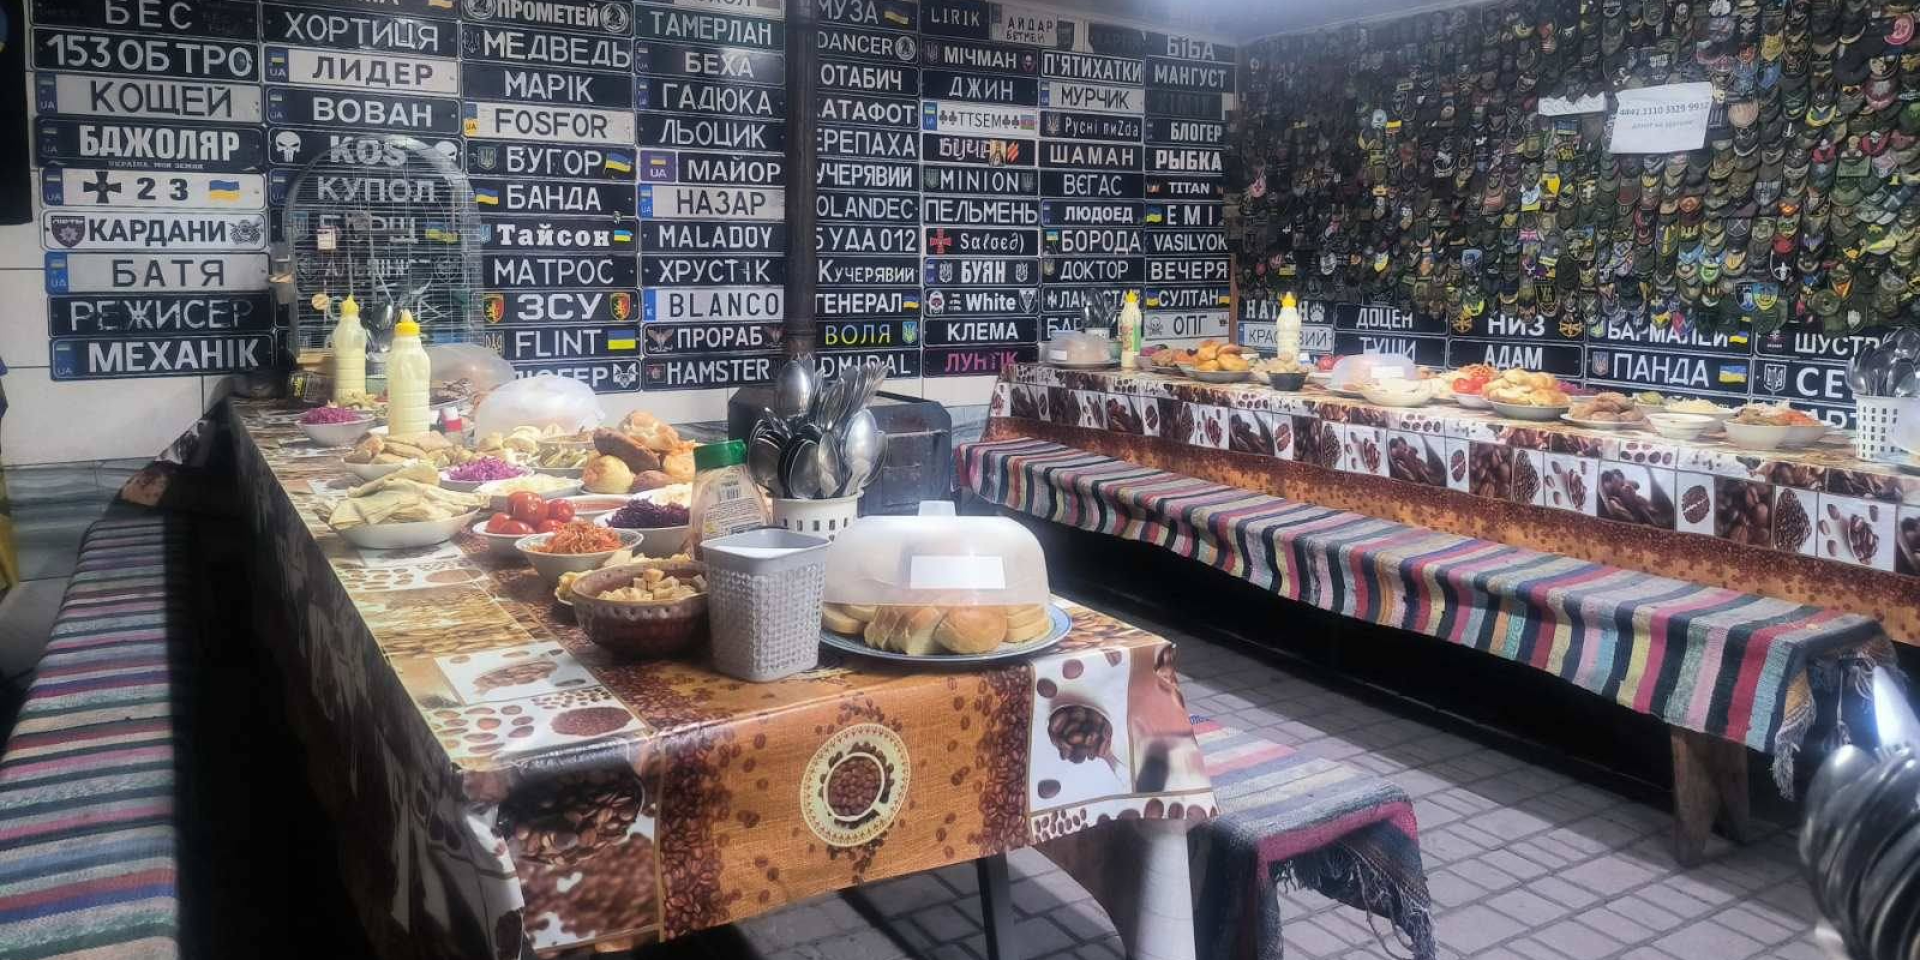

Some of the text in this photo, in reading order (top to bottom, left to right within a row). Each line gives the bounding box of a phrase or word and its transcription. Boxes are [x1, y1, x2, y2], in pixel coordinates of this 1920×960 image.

[105, 0, 192, 29] БЕС
[497, 0, 599, 27] ПРОМЕТЕЙ
[931, 9, 980, 27] LIRIK
[285, 12, 438, 52] ХОРТИЦЯ
[650, 11, 772, 45] ТАМЕРЛАН
[46, 34, 111, 67] 153
[175, 43, 253, 77] ТРО
[483, 30, 631, 68] МЕДВЕДЬ
[818, 31, 892, 55] DANCER
[684, 52, 754, 78] БЕХА
[944, 46, 1017, 69] МІЧМАН
[1043, 53, 1142, 83] П'ЯТИХАТКИ
[269, 69, 286, 77] UA
[312, 56, 433, 87] ЛИДЕР
[1154, 64, 1227, 89] МАНГУСТ
[90, 80, 232, 118] КОЩЕЙ
[504, 70, 594, 103] МАРІК
[662, 83, 773, 115] ГАДЮКА
[948, 77, 1014, 101] ДЖИН
[1061, 86, 1130, 110] МУРЧИК
[312, 96, 433, 127] ВОВАН
[494, 108, 608, 139] FOSFOR
[818, 99, 916, 125] АТАФОТ
[958, 111, 1002, 128] TTSEM
[79, 124, 240, 163] БДЖОЛЯР
[659, 118, 766, 149] ЛЬОЦИК
[817, 128, 916, 157] ЕРЕПАХА
[1170, 122, 1223, 143] БЛОГЕР
[507, 146, 601, 176] БУГОР
[1049, 144, 1134, 166] ШАМАН
[1155, 149, 1223, 171] РЫБКА
[650, 169, 668, 178] UA
[688, 156, 781, 183] МАЙОР
[817, 162, 913, 188] УЧЕРЯВИЙ
[940, 168, 1019, 192] MINION
[317, 175, 436, 204] КУПОЛ
[507, 184, 601, 211] БАНДА
[1063, 174, 1123, 196] ВЄГАС
[1168, 181, 1211, 195] TITAN
[677, 188, 767, 216] НАЗАР
[816, 195, 914, 219] OLANDEC
[924, 200, 1038, 225] ПЕЛЬМЕНЬ
[1064, 206, 1134, 224] ЛЮДОЕД
[89, 218, 227, 247] КАРДАНИ
[497, 222, 611, 247] Тайсон
[659, 224, 773, 248] MALADOY
[1061, 230, 1141, 255] БОРОДА
[1152, 233, 1229, 252] VASILYOK
[112, 259, 225, 287] БАТЯ
[494, 258, 614, 285] МАТРОС
[659, 259, 771, 283] ХРУСТІК
[960, 260, 1006, 283] БУЯН
[1060, 260, 1129, 280] ДОКТОР
[1151, 260, 1228, 281] ВЕЧЕРЯ
[517, 293, 603, 321] ЗСУ
[669, 291, 779, 318] BLANCO
[815, 292, 902, 314] ГЕНЕРАЛ
[965, 292, 1016, 312] White
[1158, 289, 1219, 307] СУЛТАН
[1246, 299, 1308, 321] НАТН
[70, 299, 254, 331] РЕЖИСЕР
[1173, 315, 1208, 335] ОПГ
[515, 329, 601, 357] FLINT
[677, 325, 763, 349] ПРОРАБ
[825, 324, 891, 345] ВОЛЯ
[947, 322, 1019, 341] КЛЕМА
[88, 339, 259, 373] МЕХАНІК
[1483, 343, 1543, 370] АДАМ
[666, 358, 770, 386] HAMSTER
[1612, 352, 1709, 388] ПАНДА
